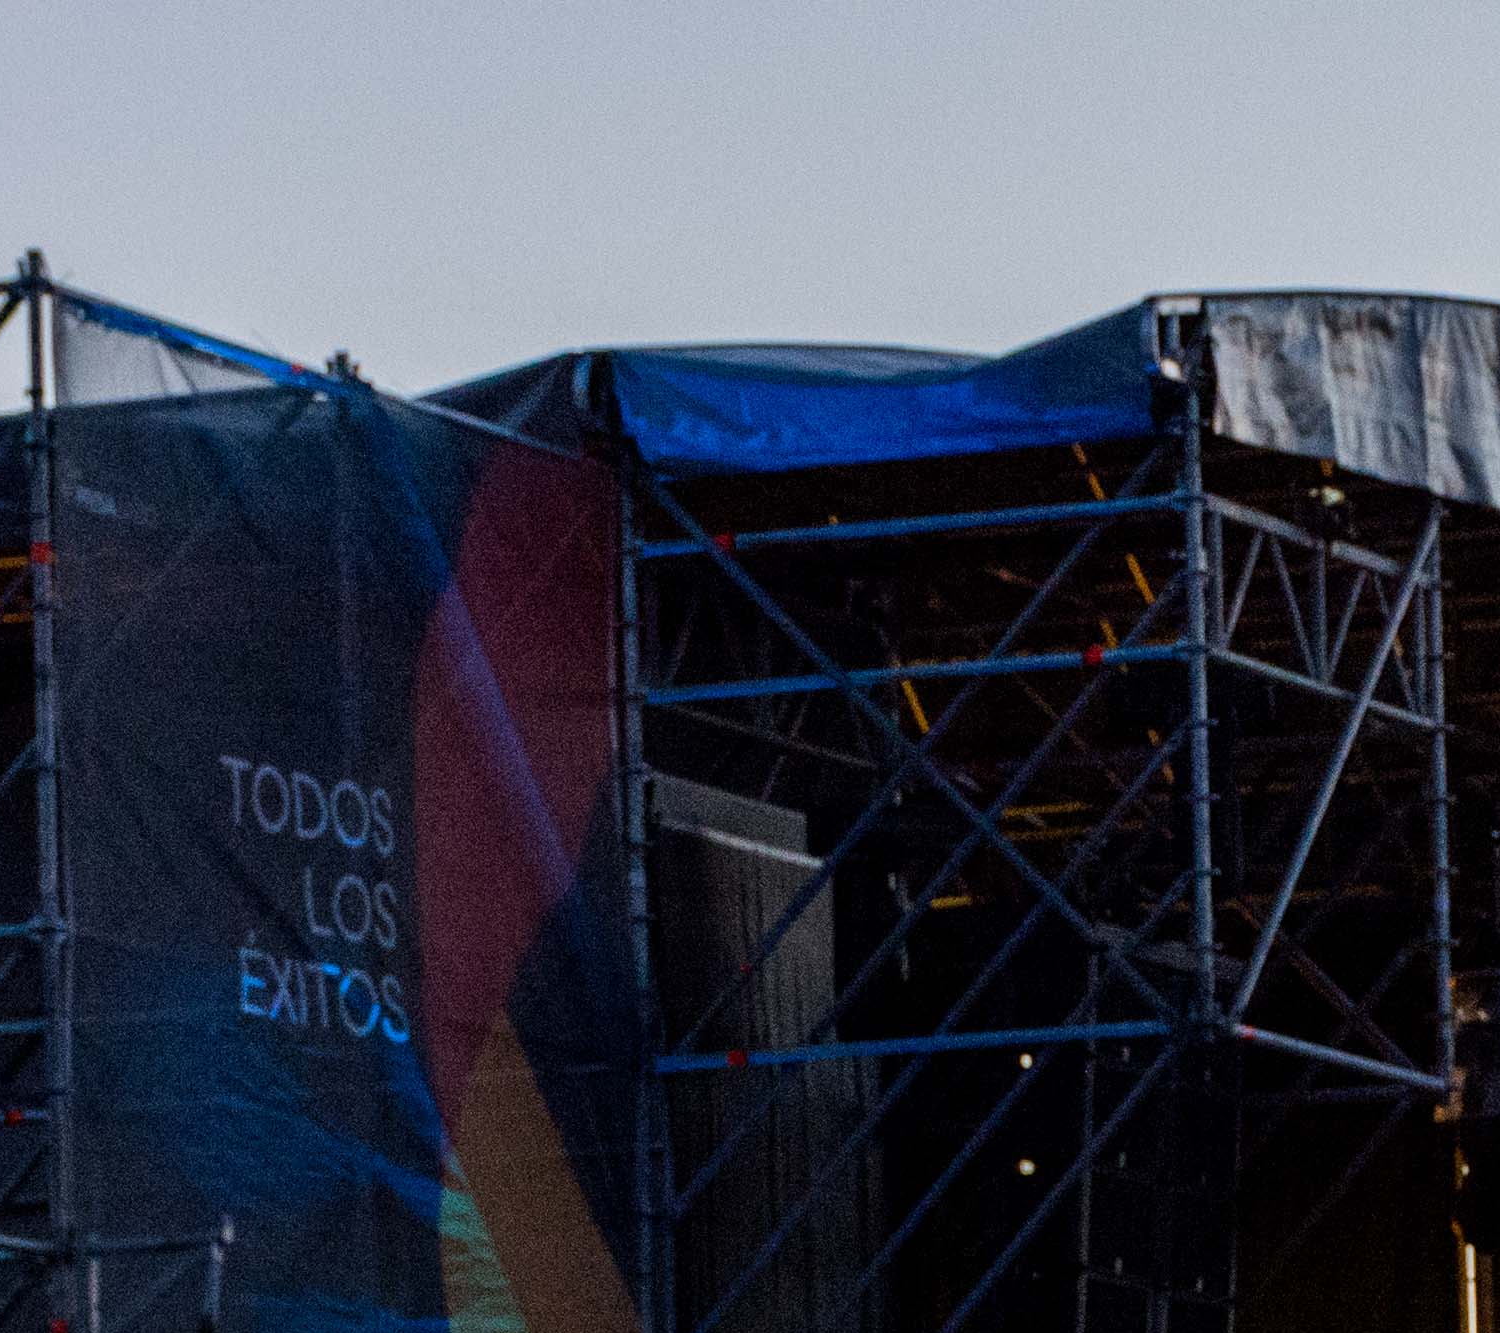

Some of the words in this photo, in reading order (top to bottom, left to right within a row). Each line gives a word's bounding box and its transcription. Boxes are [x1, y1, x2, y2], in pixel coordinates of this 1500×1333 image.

[220, 754, 396, 859] TODOS
[303, 865, 399, 950] LOS
[238, 930, 411, 1044] ÉXITOS
